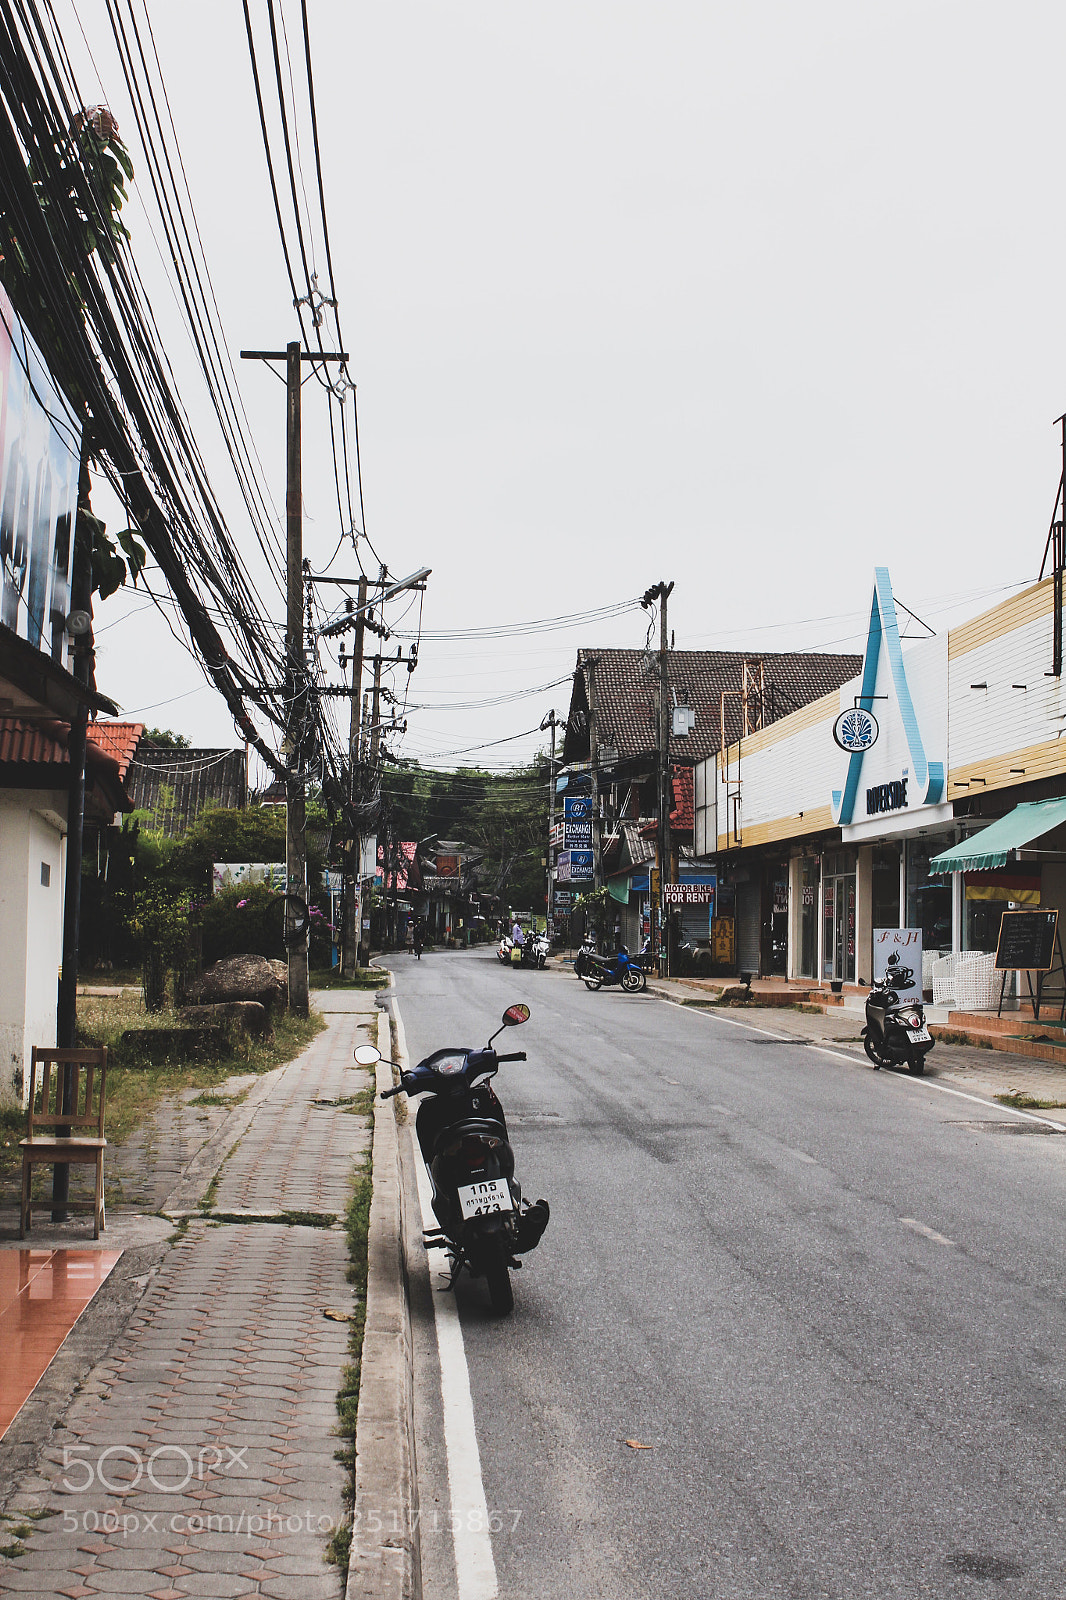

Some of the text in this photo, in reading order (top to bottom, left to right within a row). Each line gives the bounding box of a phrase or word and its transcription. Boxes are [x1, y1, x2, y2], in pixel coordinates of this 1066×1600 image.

[866, 778, 908, 814] RIVERSIDE
[666, 892, 710, 903] FOR RENT
[877, 931, 919, 946] F & H
[474, 1203, 501, 1216] 473
